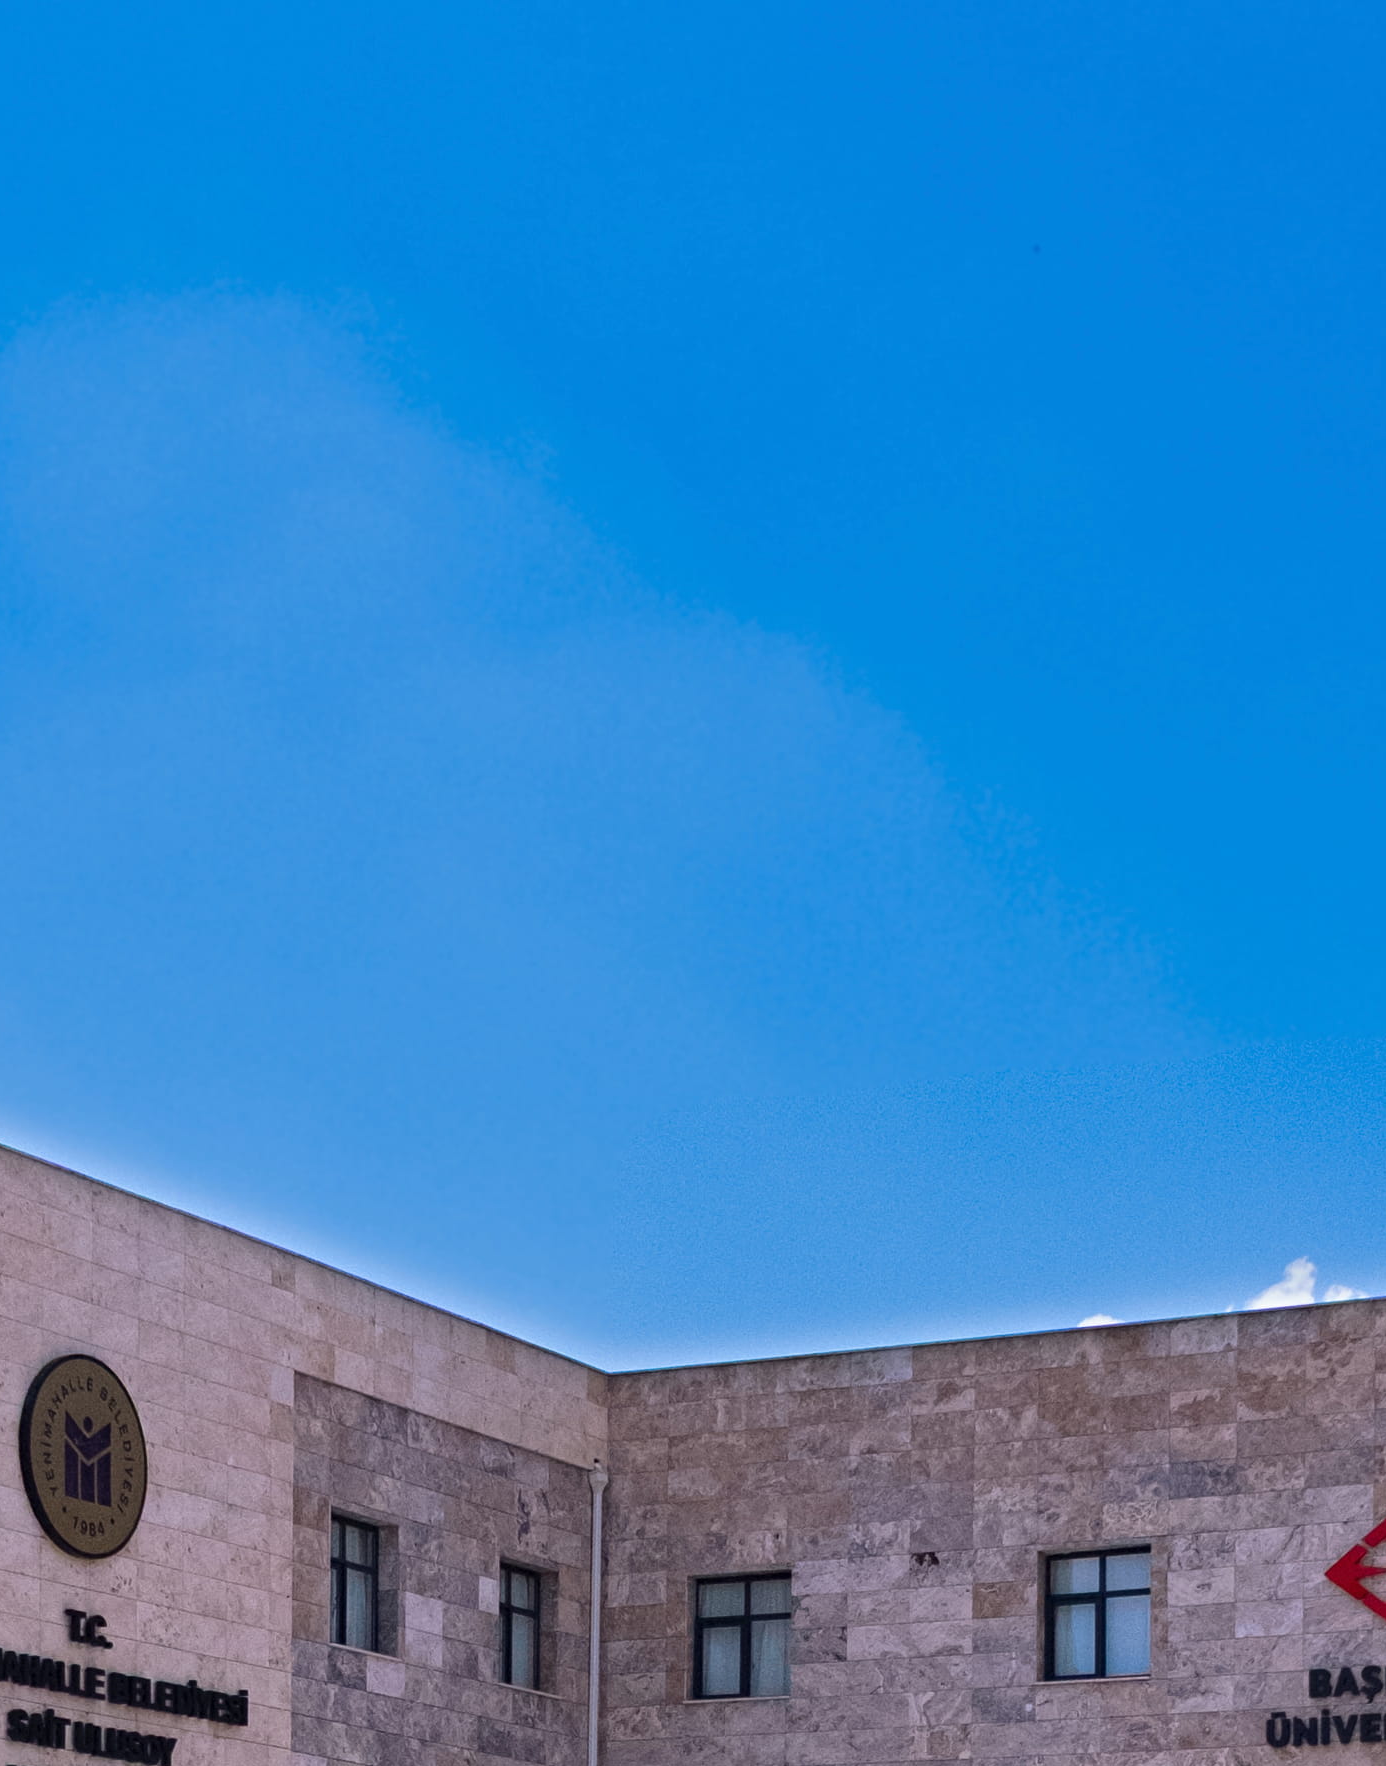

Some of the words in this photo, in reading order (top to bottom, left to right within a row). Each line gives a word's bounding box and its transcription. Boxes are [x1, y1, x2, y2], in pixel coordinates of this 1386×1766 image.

[42, 1377, 93, 1497] YENİMAHALLE
[100, 1386, 133, 1514] BELEDİYESİ
[72, 1516, 105, 1537] 1984
[65, 1608, 113, 1649] T.C.
[107, 1671, 249, 1726] BELEDİYESİ
[6, 1708, 72, 1751] SAİT
